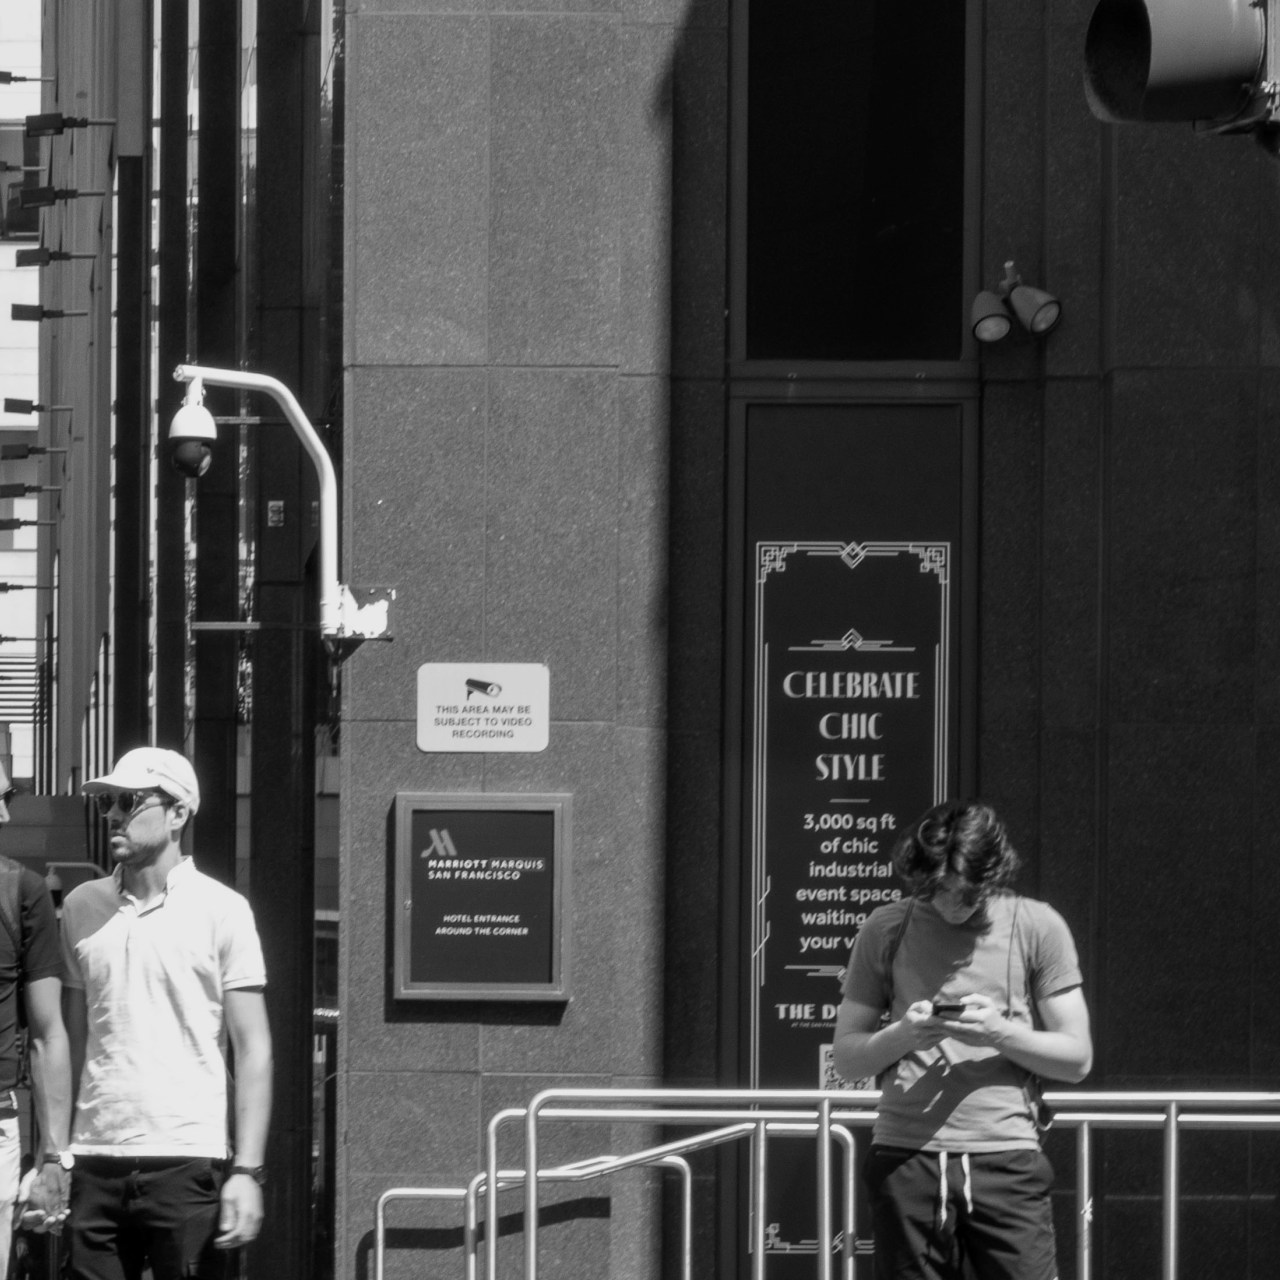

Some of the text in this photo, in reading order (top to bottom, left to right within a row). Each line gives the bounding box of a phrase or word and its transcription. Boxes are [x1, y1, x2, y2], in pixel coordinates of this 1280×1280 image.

[783, 671, 921, 699] CELEBRATE
[436, 705, 531, 714] THIS AREA MAY BE
[434, 717, 533, 727] SUBJECT TO VIDEO
[818, 712, 884, 740] CHIC
[452, 729, 514, 739] RECORDING
[815, 753, 886, 781] STYLE
[803, 813, 897, 834] 3,000 sq ft
[820, 837, 879, 854] of chic
[428, 859, 544, 869] MARRIOTT MARQUIS
[809, 861, 893, 878] industrial
[428, 870, 521, 880] SAN FRANCISCO
[795, 886, 902, 906] event space
[443, 914, 520, 923] HOTEL ENTRANCE
[435, 926, 529, 936] AROUND THE CORNER
[799, 936, 841, 954] your
[774, 1003, 816, 1020] THE
